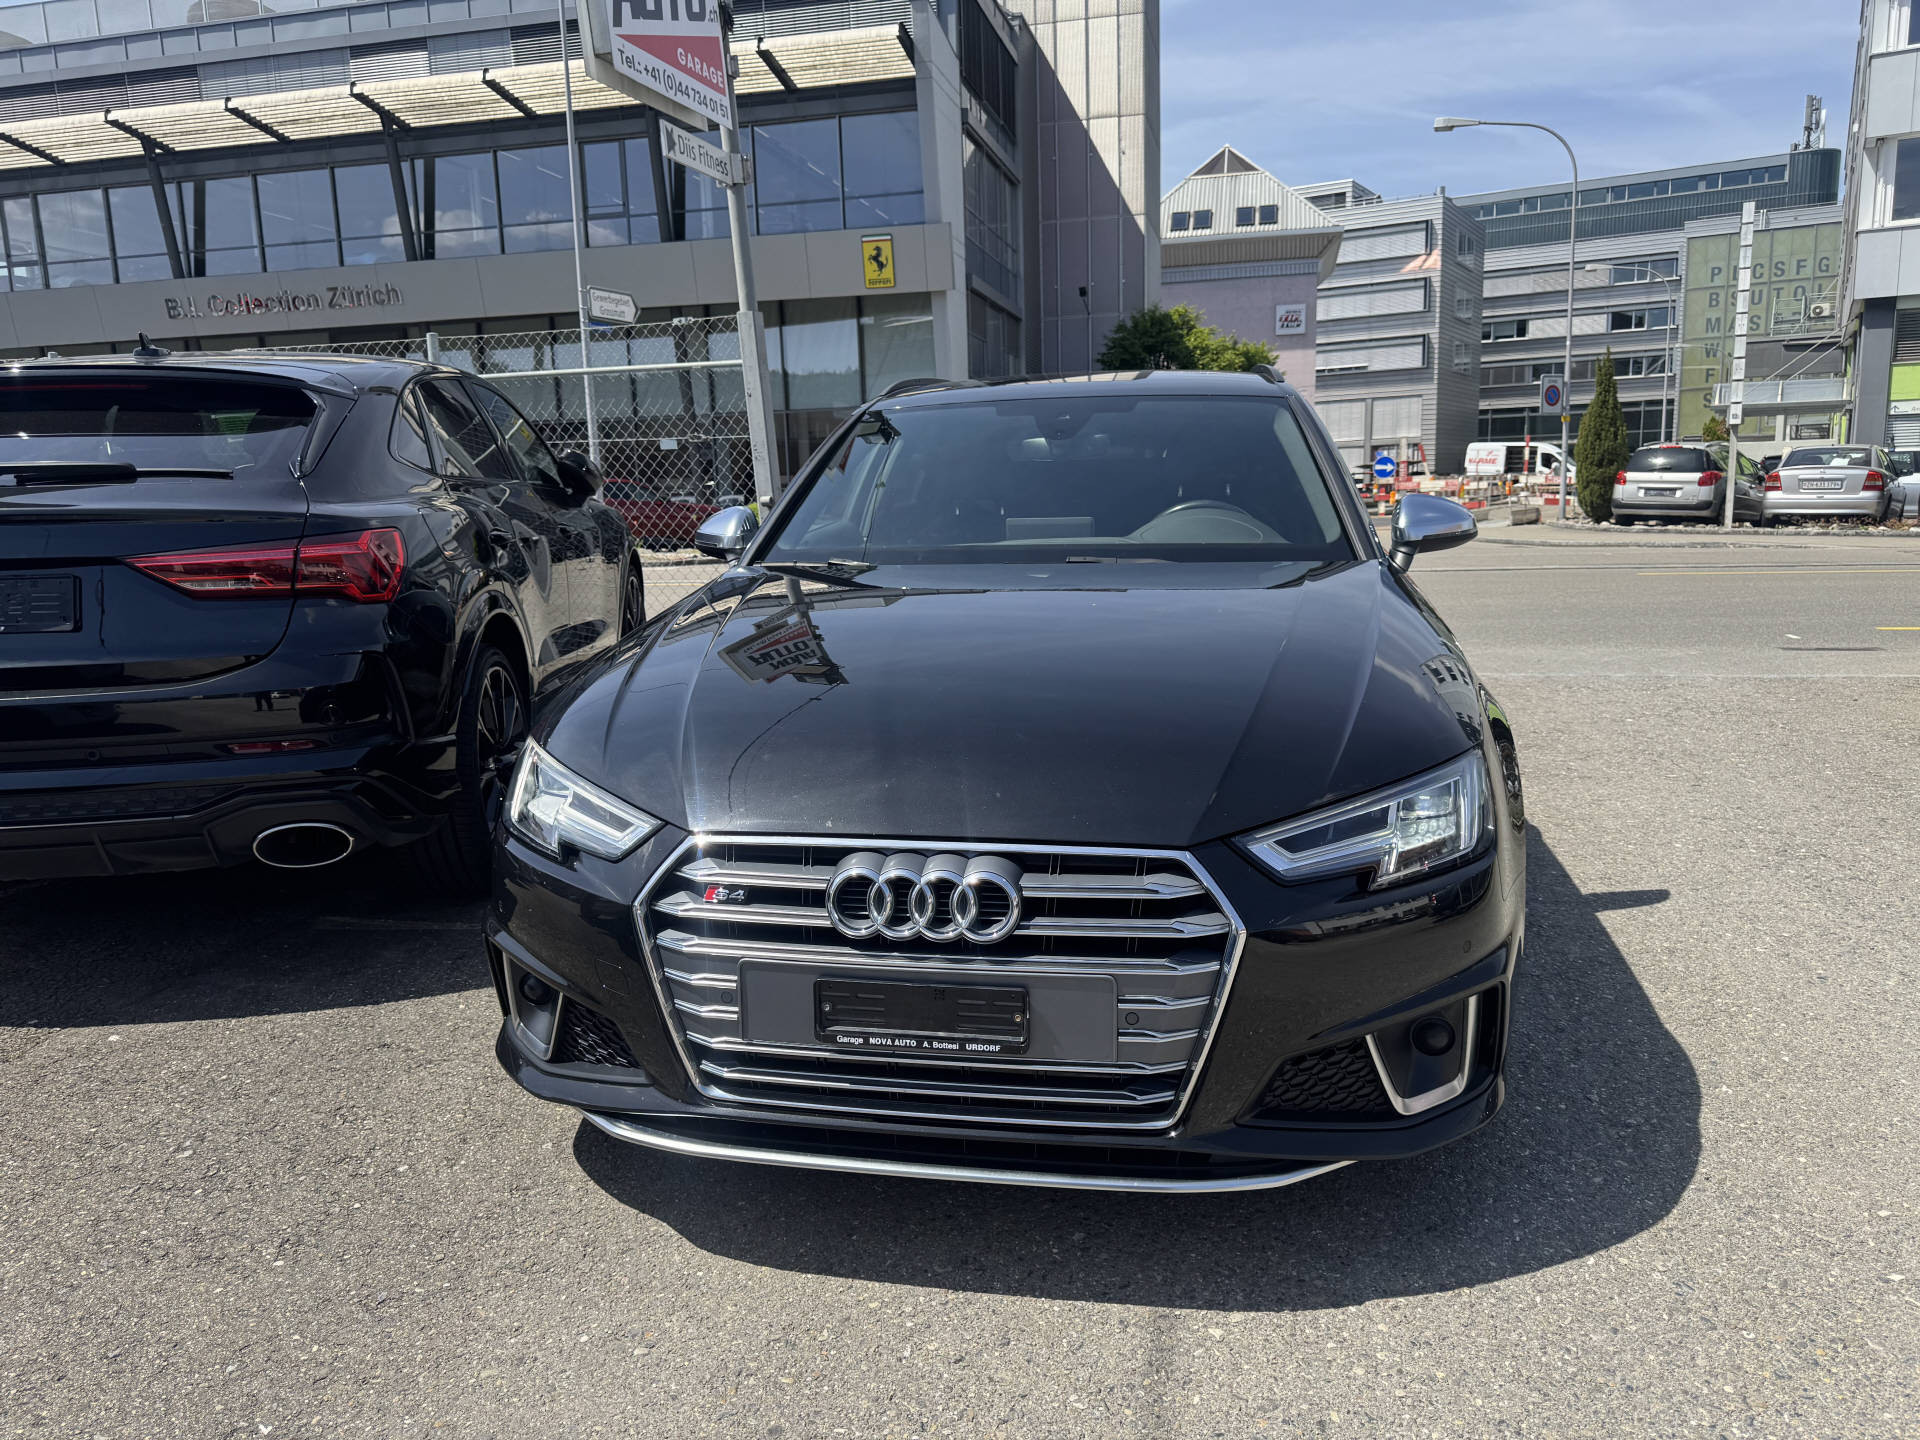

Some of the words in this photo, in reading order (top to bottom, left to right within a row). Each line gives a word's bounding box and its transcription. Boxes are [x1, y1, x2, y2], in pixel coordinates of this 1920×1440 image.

[677, 48, 724, 88] GARAGE
[691, 88, 708, 110] 734
[698, 144, 729, 177] Fitness
[208, 289, 322, 317] Collection
[326, 282, 402, 310] Zürich
[836, 1035, 864, 1045] Garage
[869, 1037, 892, 1046] NOVA
[894, 1039, 917, 1047] AUTO
[932, 1041, 959, 1050] Bottesi
[965, 1044, 1001, 1052] URDORF
